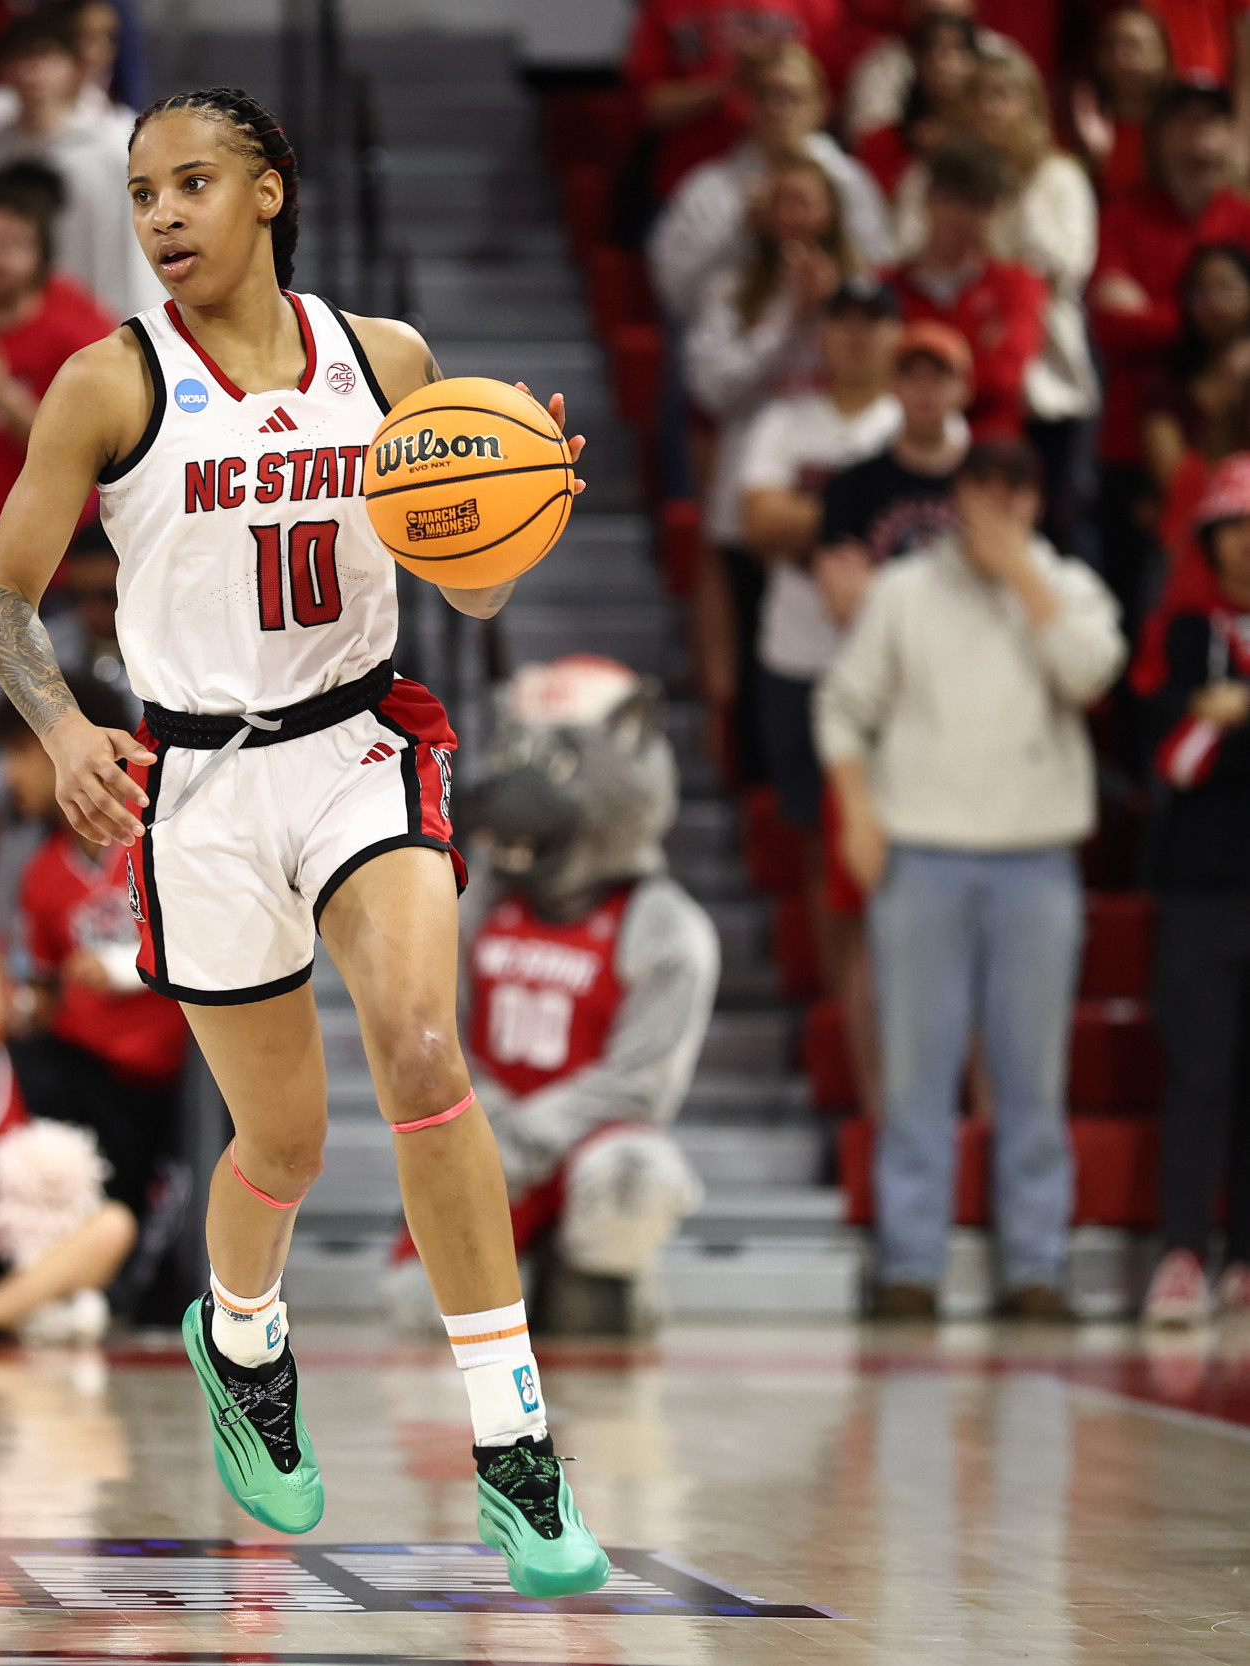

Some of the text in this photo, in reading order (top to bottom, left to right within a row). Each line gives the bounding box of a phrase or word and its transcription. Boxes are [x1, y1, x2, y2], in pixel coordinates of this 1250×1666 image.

[330, 371, 353, 380] ACC
[179, 394, 207, 404] NCAA
[376, 428, 503, 477] Wilson
[409, 461, 451, 473] EVO NXT
[185, 445, 370, 514] NC STAT
[417, 507, 456, 525] MARCH
[425, 514, 478, 535] MADNESS
[248, 519, 342, 631] 10
